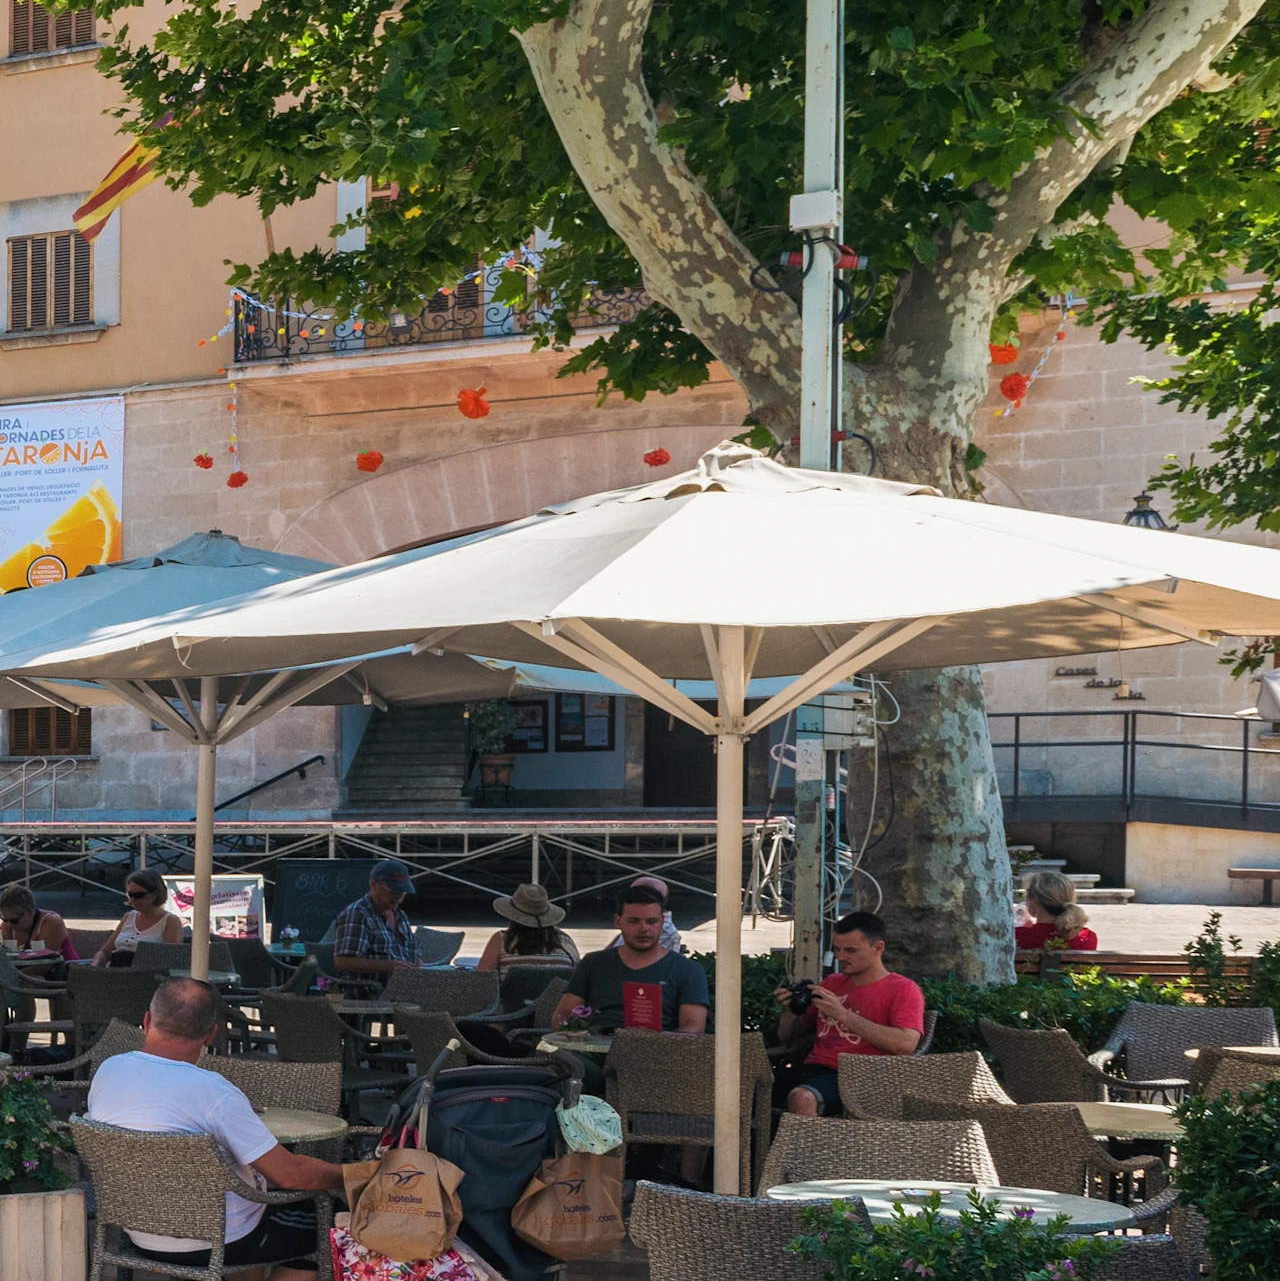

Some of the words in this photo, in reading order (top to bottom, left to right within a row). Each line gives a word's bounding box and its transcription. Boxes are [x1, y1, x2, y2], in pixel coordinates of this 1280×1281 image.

[68, 427, 85, 440] DE
[87, 426, 101, 438] LA
[40, 489, 77, 497] RESTAURANTS
[1055, 666, 1097, 675] Cases
[1086, 678, 1104, 687] de
[295, 872, 330, 891] BAR
[388, 1194, 423, 1204] hoteles
